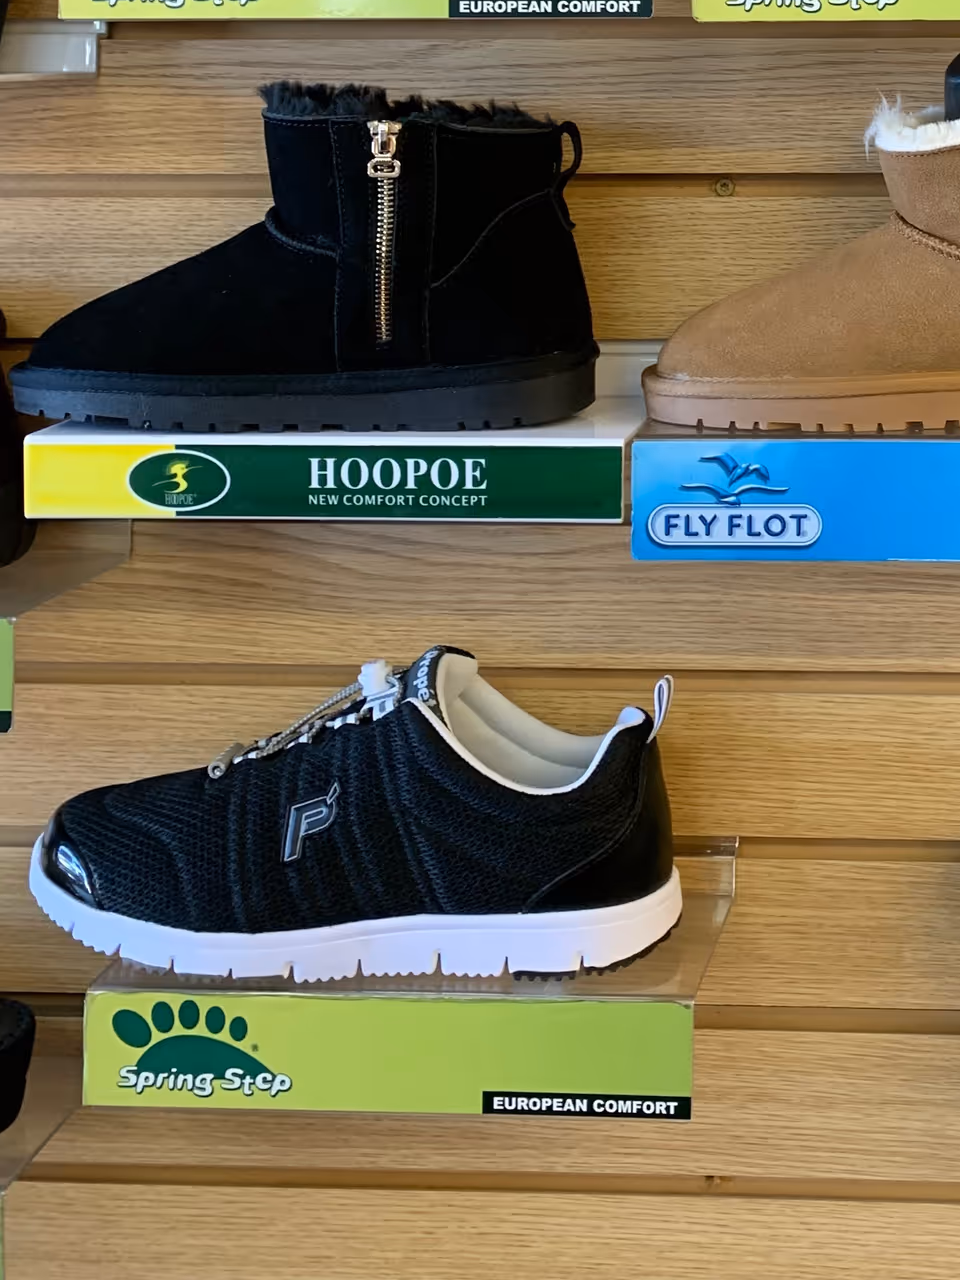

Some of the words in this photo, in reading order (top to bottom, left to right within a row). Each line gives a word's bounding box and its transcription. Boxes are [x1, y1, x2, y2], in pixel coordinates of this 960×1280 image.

[459, 0, 553, 13] EUROPEAN
[557, 0, 641, 13] COMFORT
[308, 457, 487, 490] HOOPOE
[308, 494, 339, 505] NEW
[343, 494, 415, 506] COMFORT
[419, 494, 488, 506] CONCEPT
[664, 513, 717, 537] FLY
[728, 513, 808, 537] FLOT
[117, 1065, 214, 1097] Spring
[220, 1067, 292, 1097] Step
[492, 1096, 588, 1112] EUROPEAN
[592, 1099, 679, 1115] COMFORT
